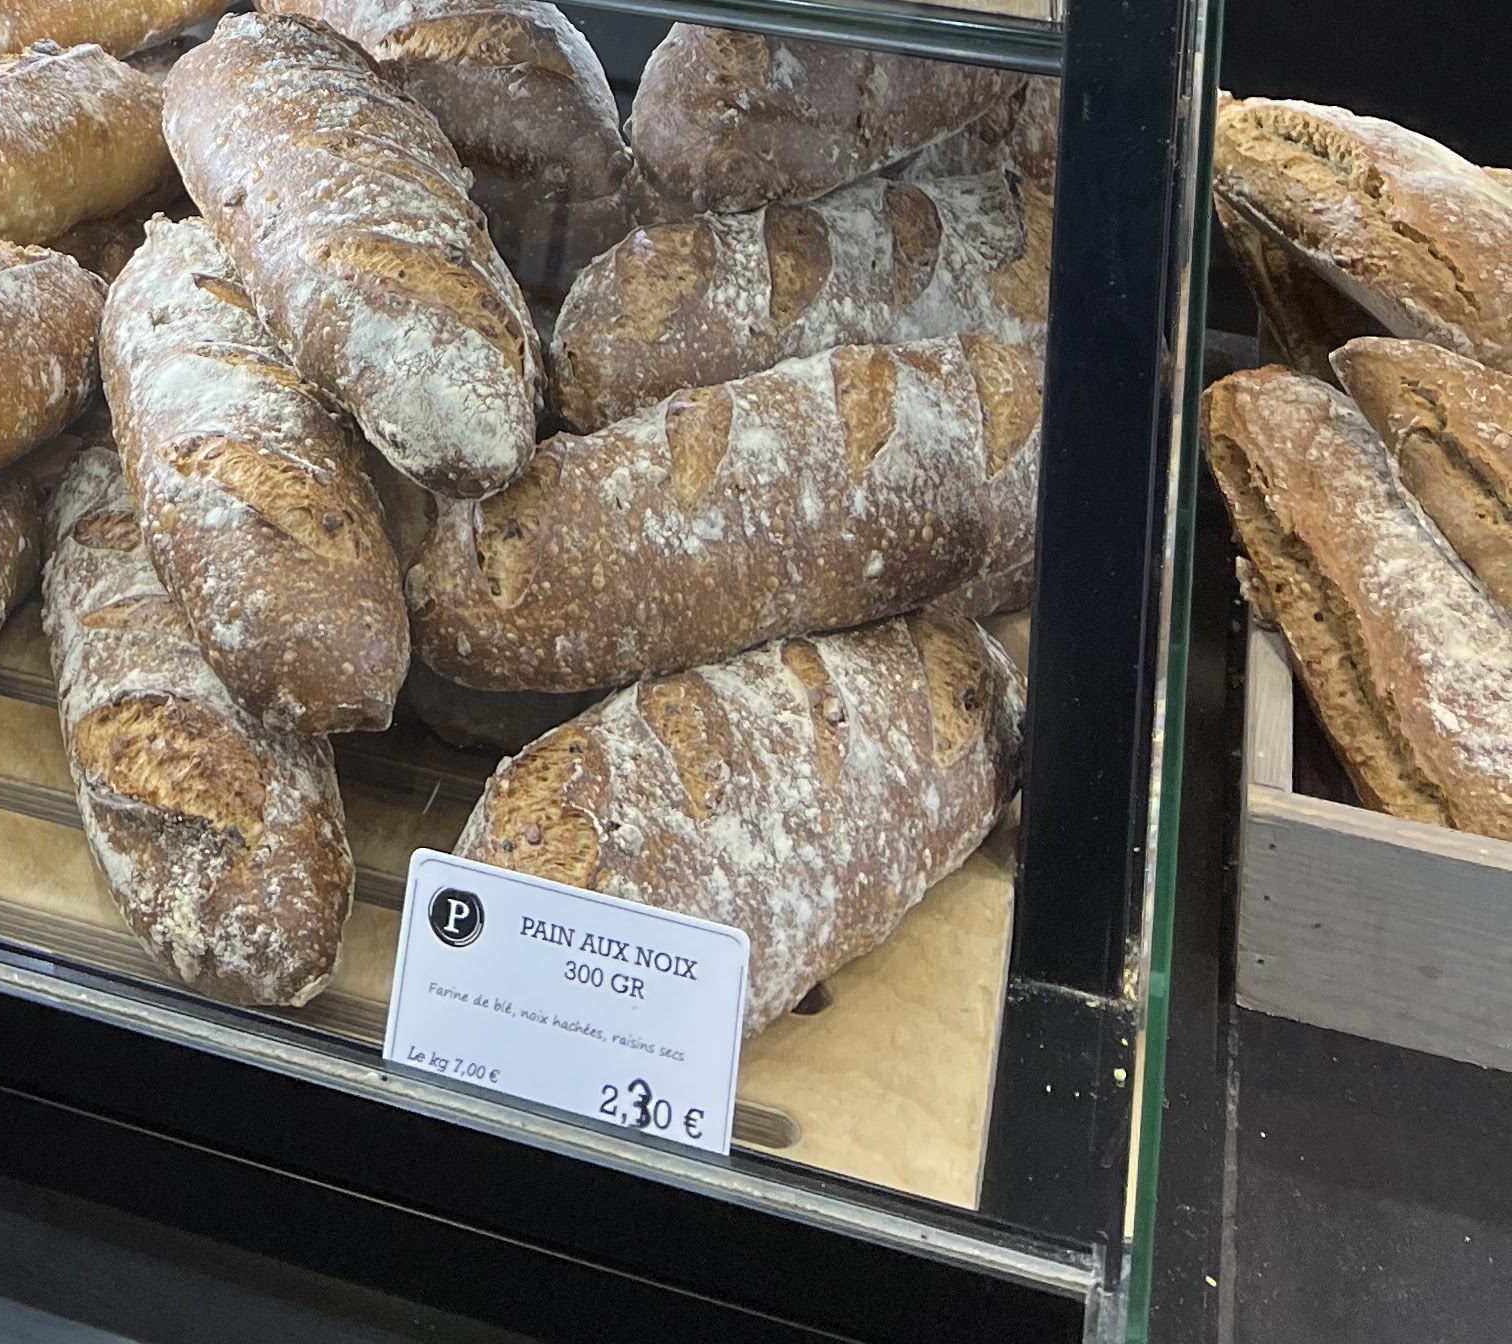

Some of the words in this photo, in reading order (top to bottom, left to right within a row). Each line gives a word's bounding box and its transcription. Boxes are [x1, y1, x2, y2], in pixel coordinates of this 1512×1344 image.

[444, 898, 470, 934] P
[520, 915, 576, 948] PAIN
[580, 935, 630, 963] AUX
[635, 946, 698, 980] NOIX
[564, 960, 604, 988] 300
[611, 973, 645, 1000] GR
[429, 982, 469, 1003] Farine
[473, 993, 489, 1010] de
[494, 997, 516, 1018] blé,
[520, 1009, 549, 1025] noix
[552, 1014, 607, 1043] hachées,
[612, 1032, 655, 1054] raisins
[659, 1044, 686, 1062] secs
[407, 1046, 427, 1063] Le
[429, 1050, 449, 1072] kg
[453, 1058, 486, 1081] 7,00
[489, 1068, 501, 1084] €
[683, 1108, 705, 1140] €
